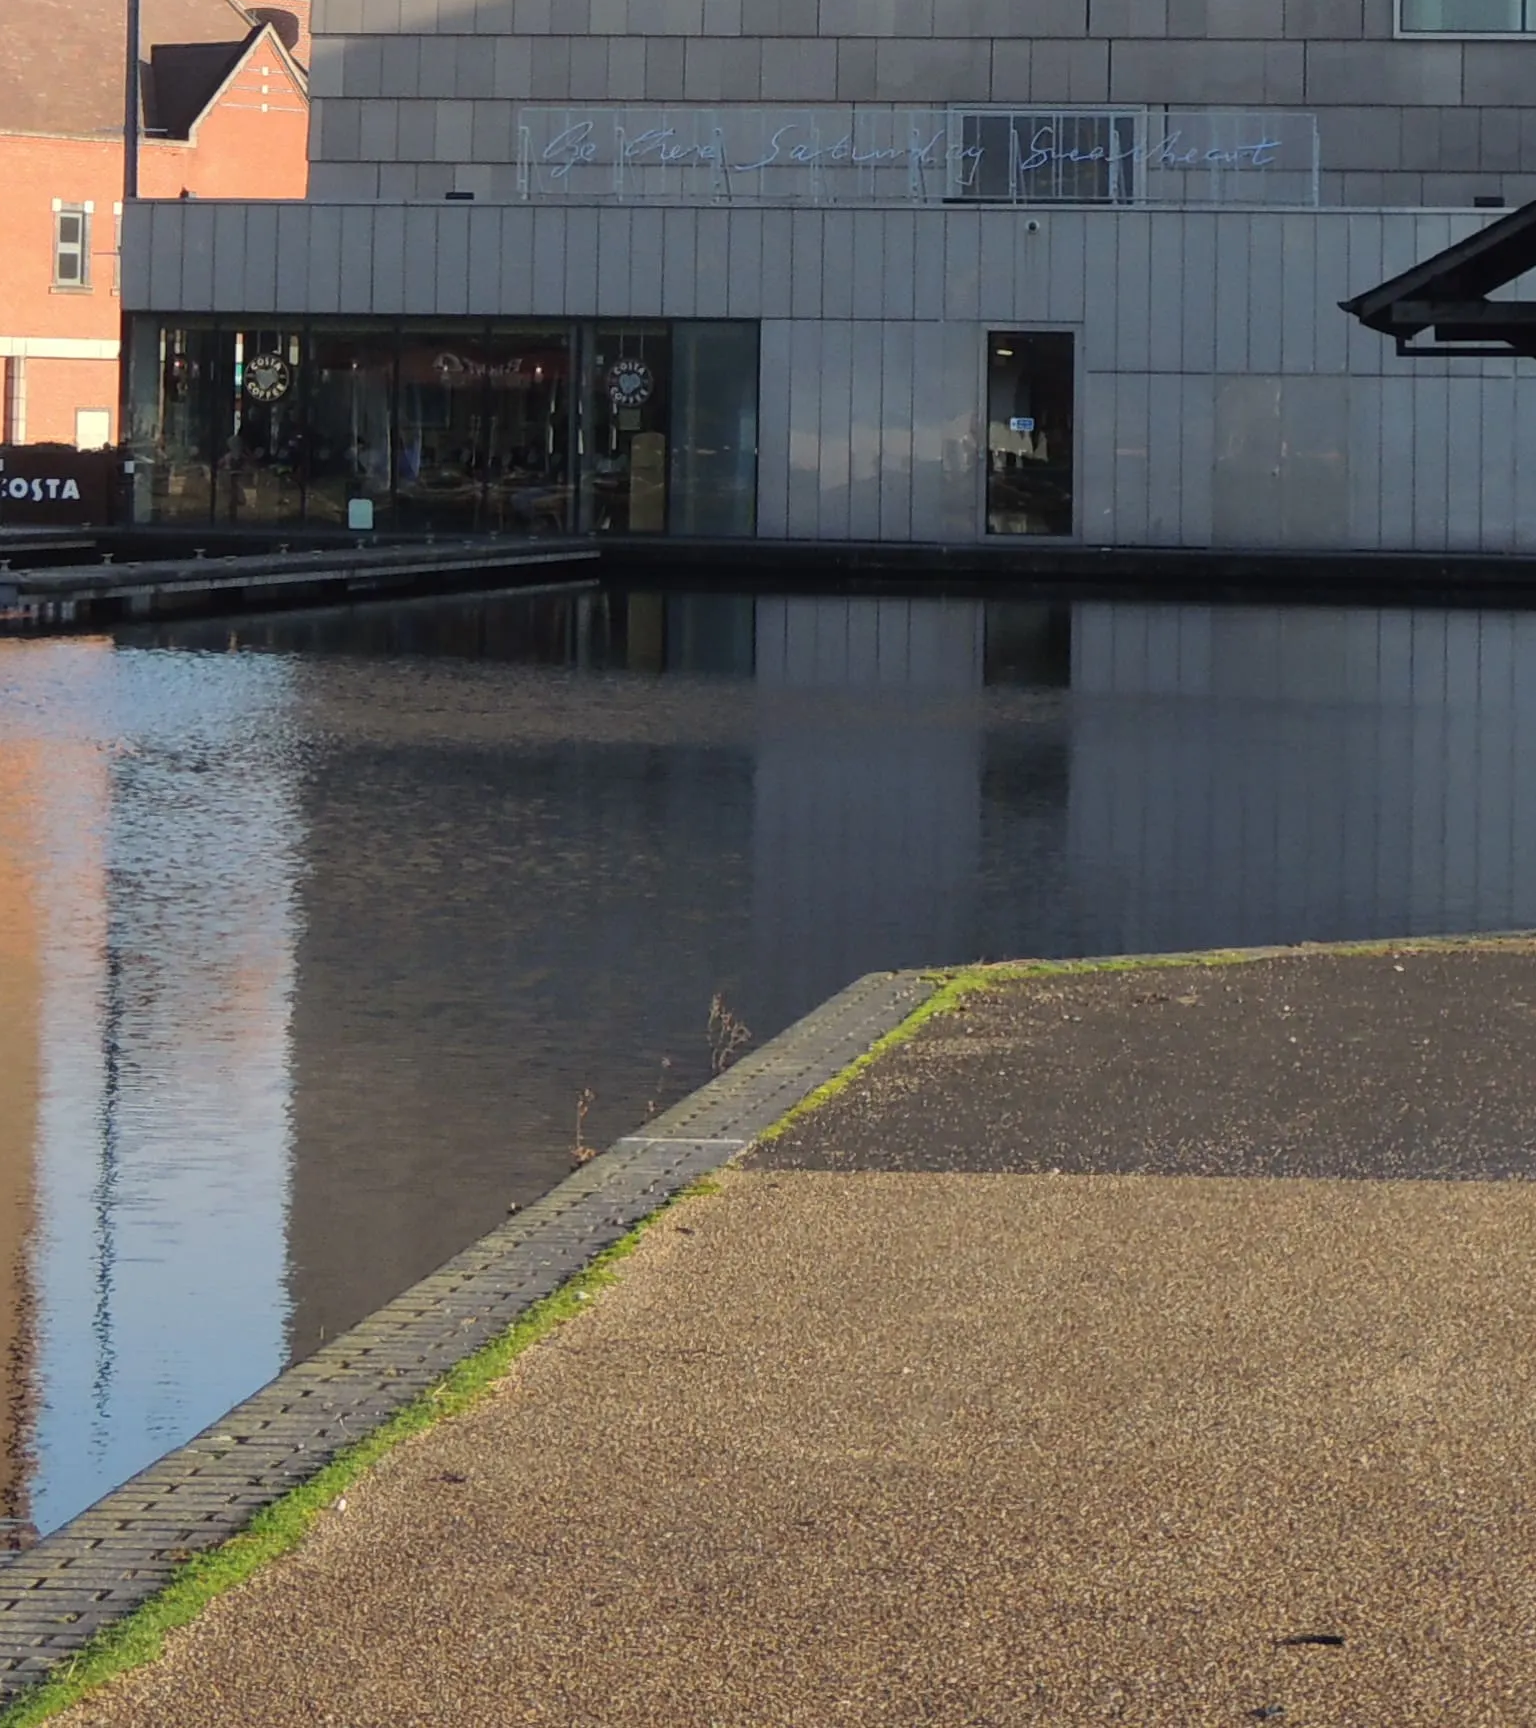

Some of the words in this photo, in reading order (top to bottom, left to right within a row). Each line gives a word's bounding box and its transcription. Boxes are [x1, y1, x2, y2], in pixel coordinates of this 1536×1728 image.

[734, 123, 985, 186] Saturday
[249, 357, 282, 372] COSTA
[613, 361, 645, 376] COSTA
[247, 381, 286, 400] COFFEE
[609, 386, 649, 403] COFFEE
